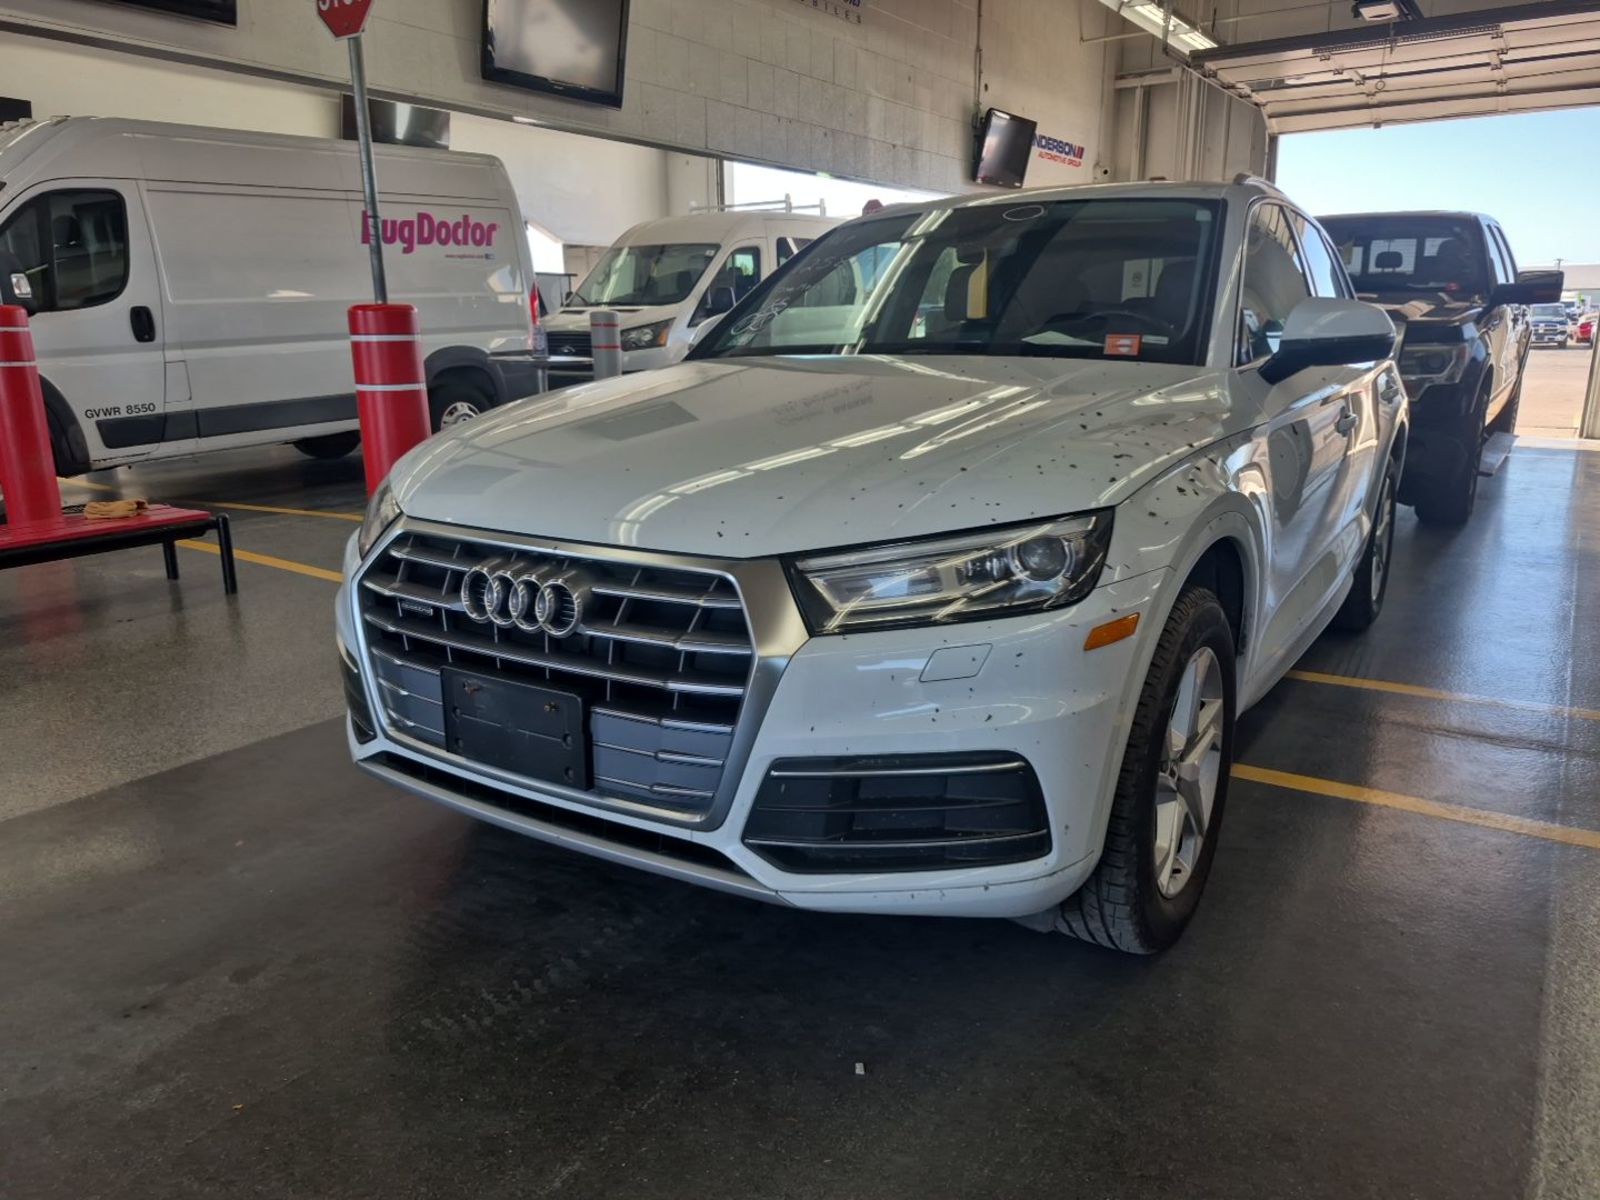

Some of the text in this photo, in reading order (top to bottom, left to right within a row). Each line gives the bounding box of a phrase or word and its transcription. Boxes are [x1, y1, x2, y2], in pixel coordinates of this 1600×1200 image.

[1032, 133, 1077, 157] NDERSON
[84, 402, 156, 419] GVWR 8550
